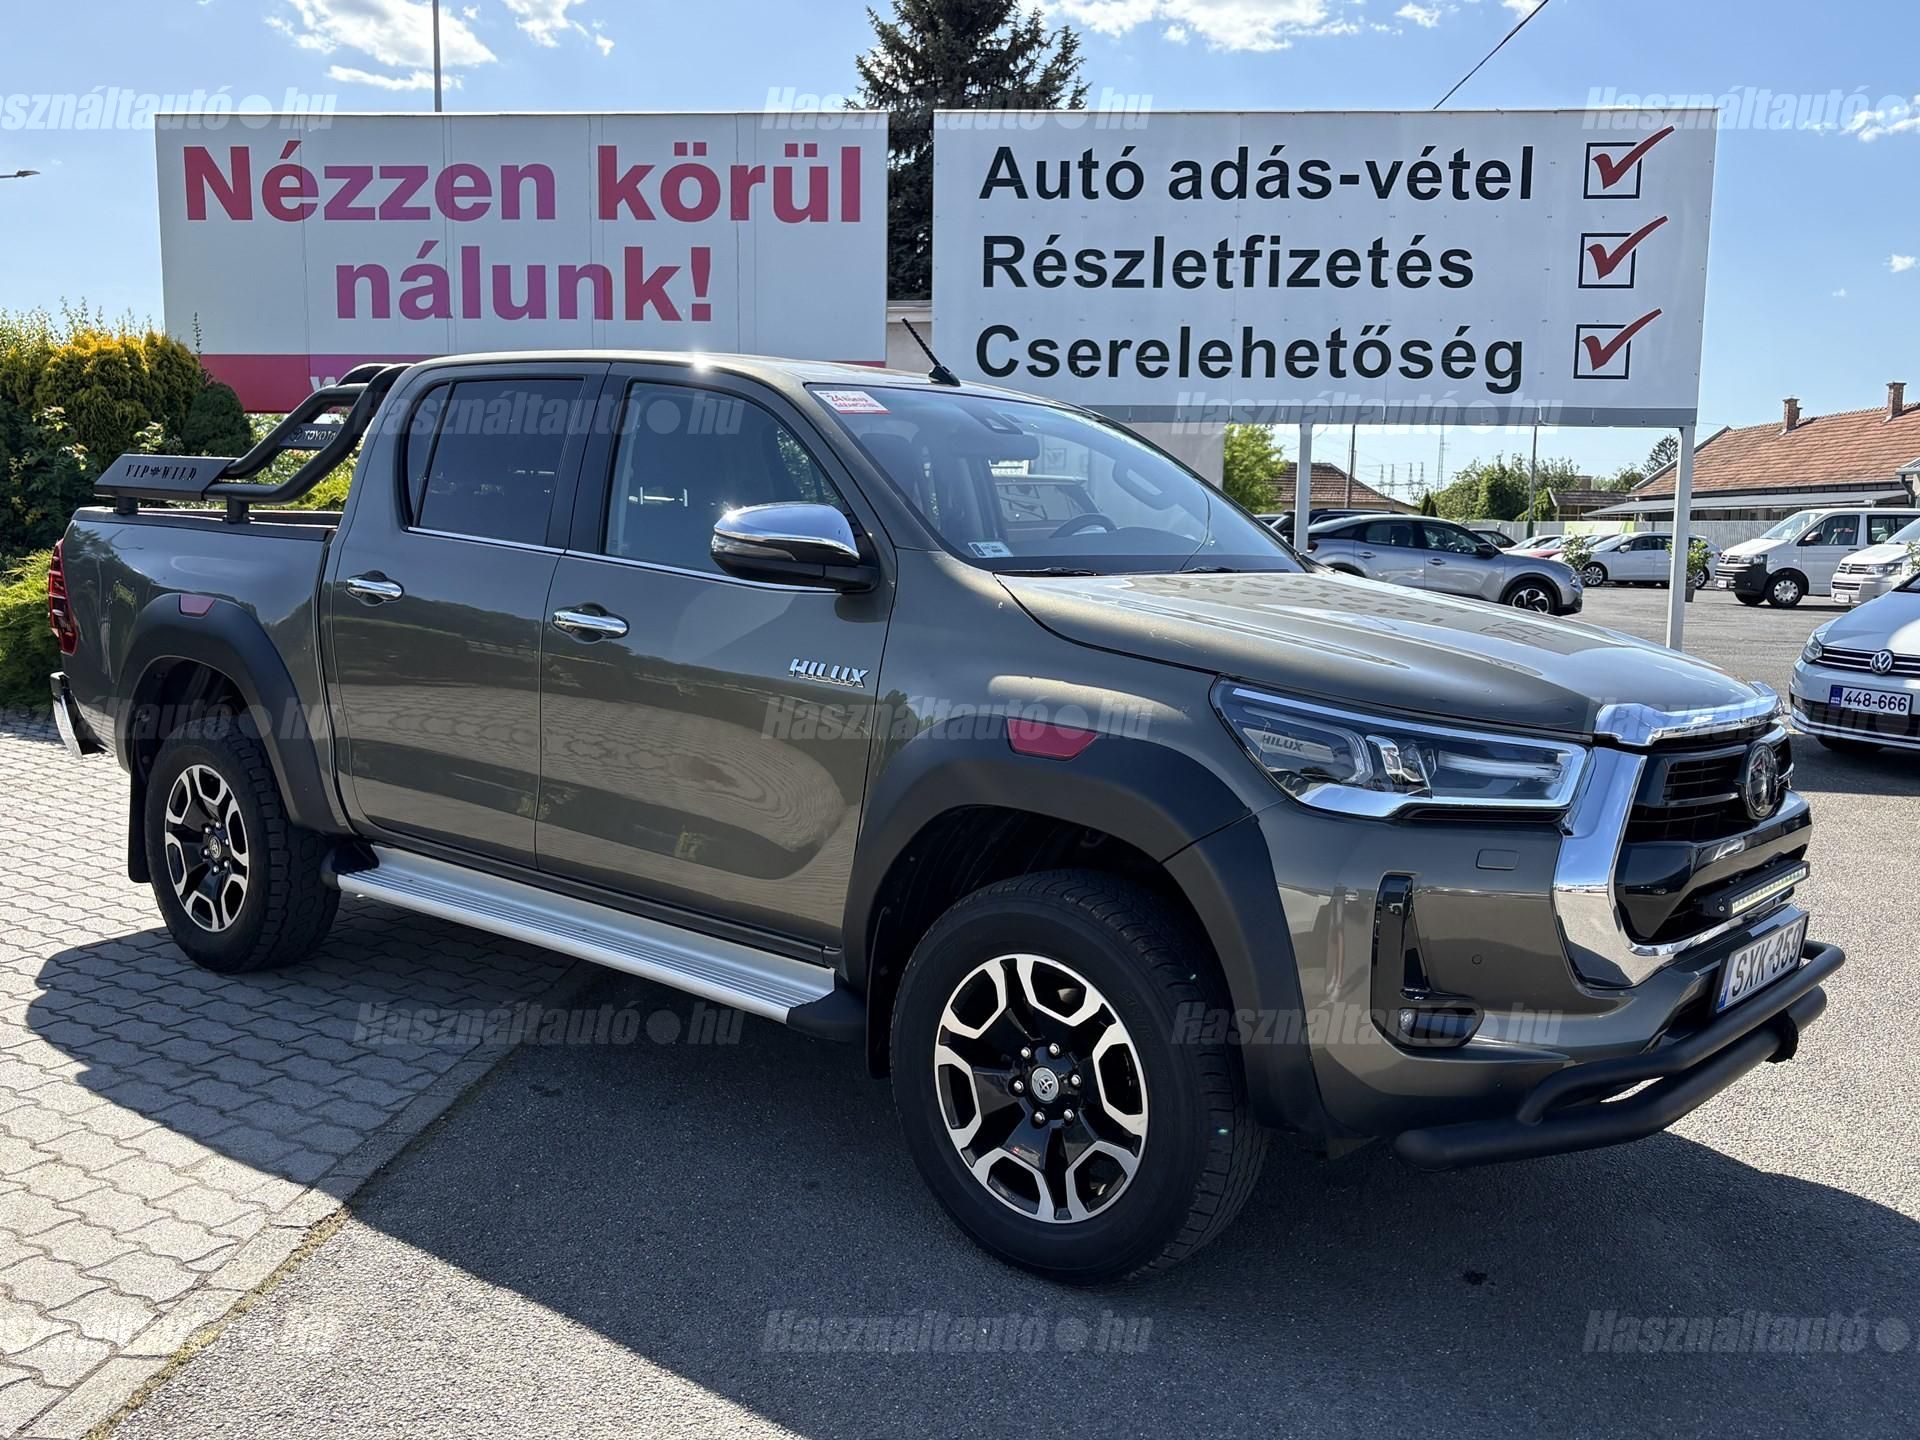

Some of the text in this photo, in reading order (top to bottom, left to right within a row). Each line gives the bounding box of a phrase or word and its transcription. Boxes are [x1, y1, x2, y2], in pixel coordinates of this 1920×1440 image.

[183, 140, 861, 223] Nézzen körül
[979, 144, 1534, 200] Autó adás-vétel
[336, 240, 711, 322] nálunk!
[982, 234, 1474, 290] Részletfizetés
[975, 323, 1523, 394] Cserelehetőség
[788, 657, 870, 688] HILUX
[1843, 690, 1907, 712] 448-666
[1262, 733, 1304, 751] HILUX
